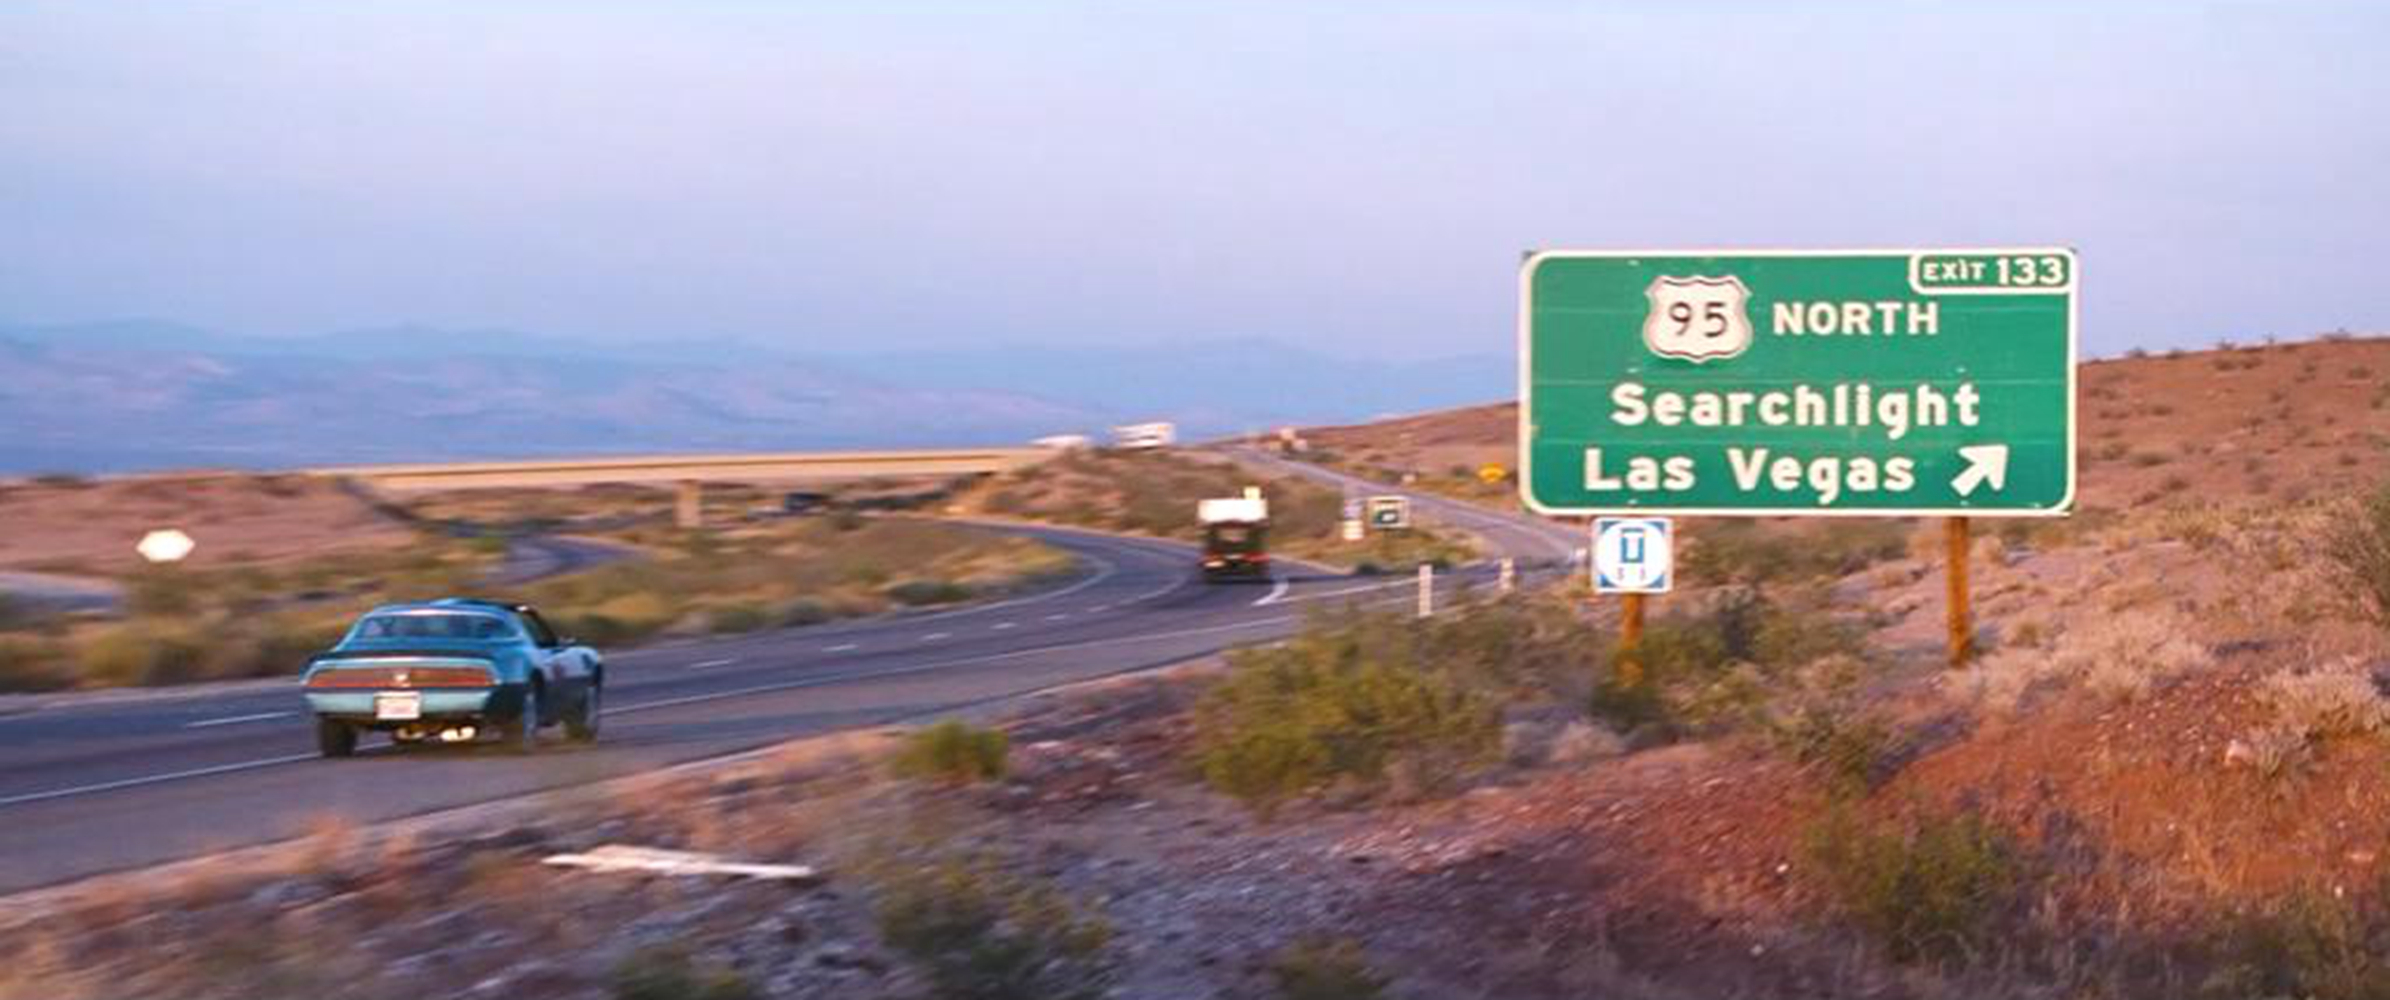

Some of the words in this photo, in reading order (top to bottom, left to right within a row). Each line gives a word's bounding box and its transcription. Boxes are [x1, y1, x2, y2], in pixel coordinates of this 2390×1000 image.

[1922, 261, 1987, 282] EXIT
[1996, 257, 2065, 285] 133
[1668, 301, 1728, 338] 95
[1772, 301, 1939, 336] NORTH
[1610, 381, 1981, 440] Searchlight
[1584, 447, 1695, 491] Las
[1726, 447, 1915, 504] Vegas
